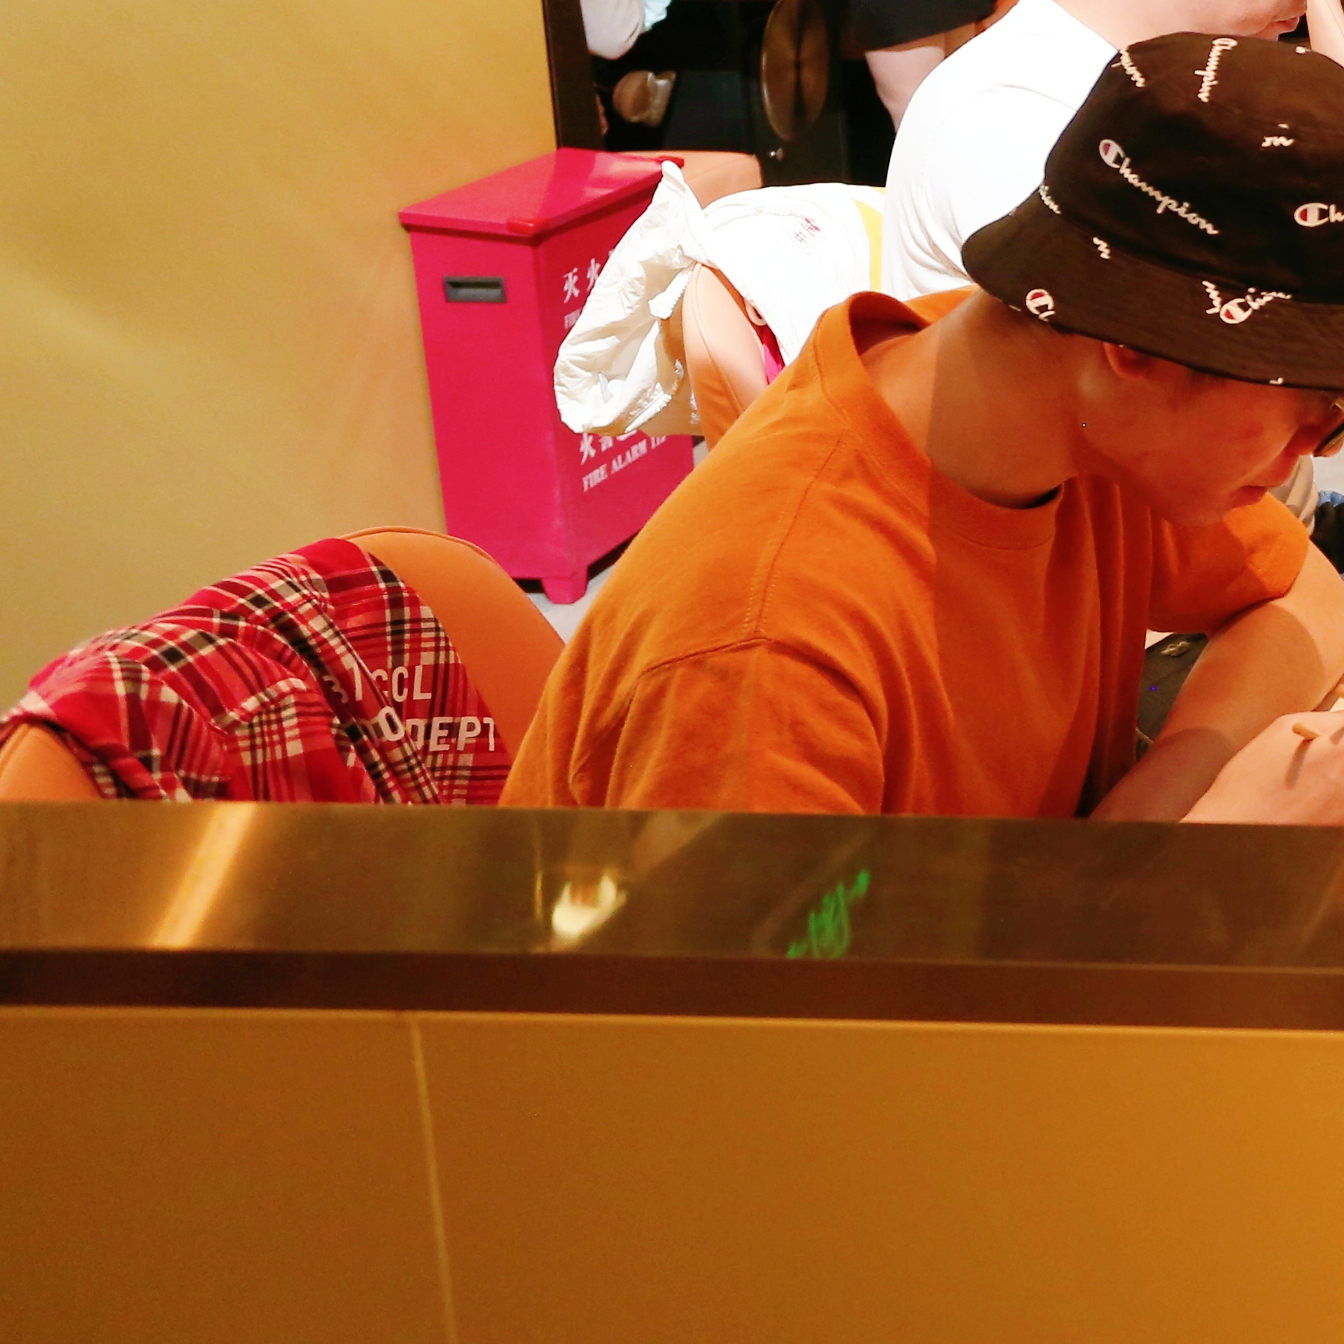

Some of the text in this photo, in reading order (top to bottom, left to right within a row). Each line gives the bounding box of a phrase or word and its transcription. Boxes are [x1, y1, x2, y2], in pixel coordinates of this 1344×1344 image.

[1098, 138, 1220, 236] Champion
[582, 463, 608, 493] FIRE
[611, 439, 648, 475] ALARM
